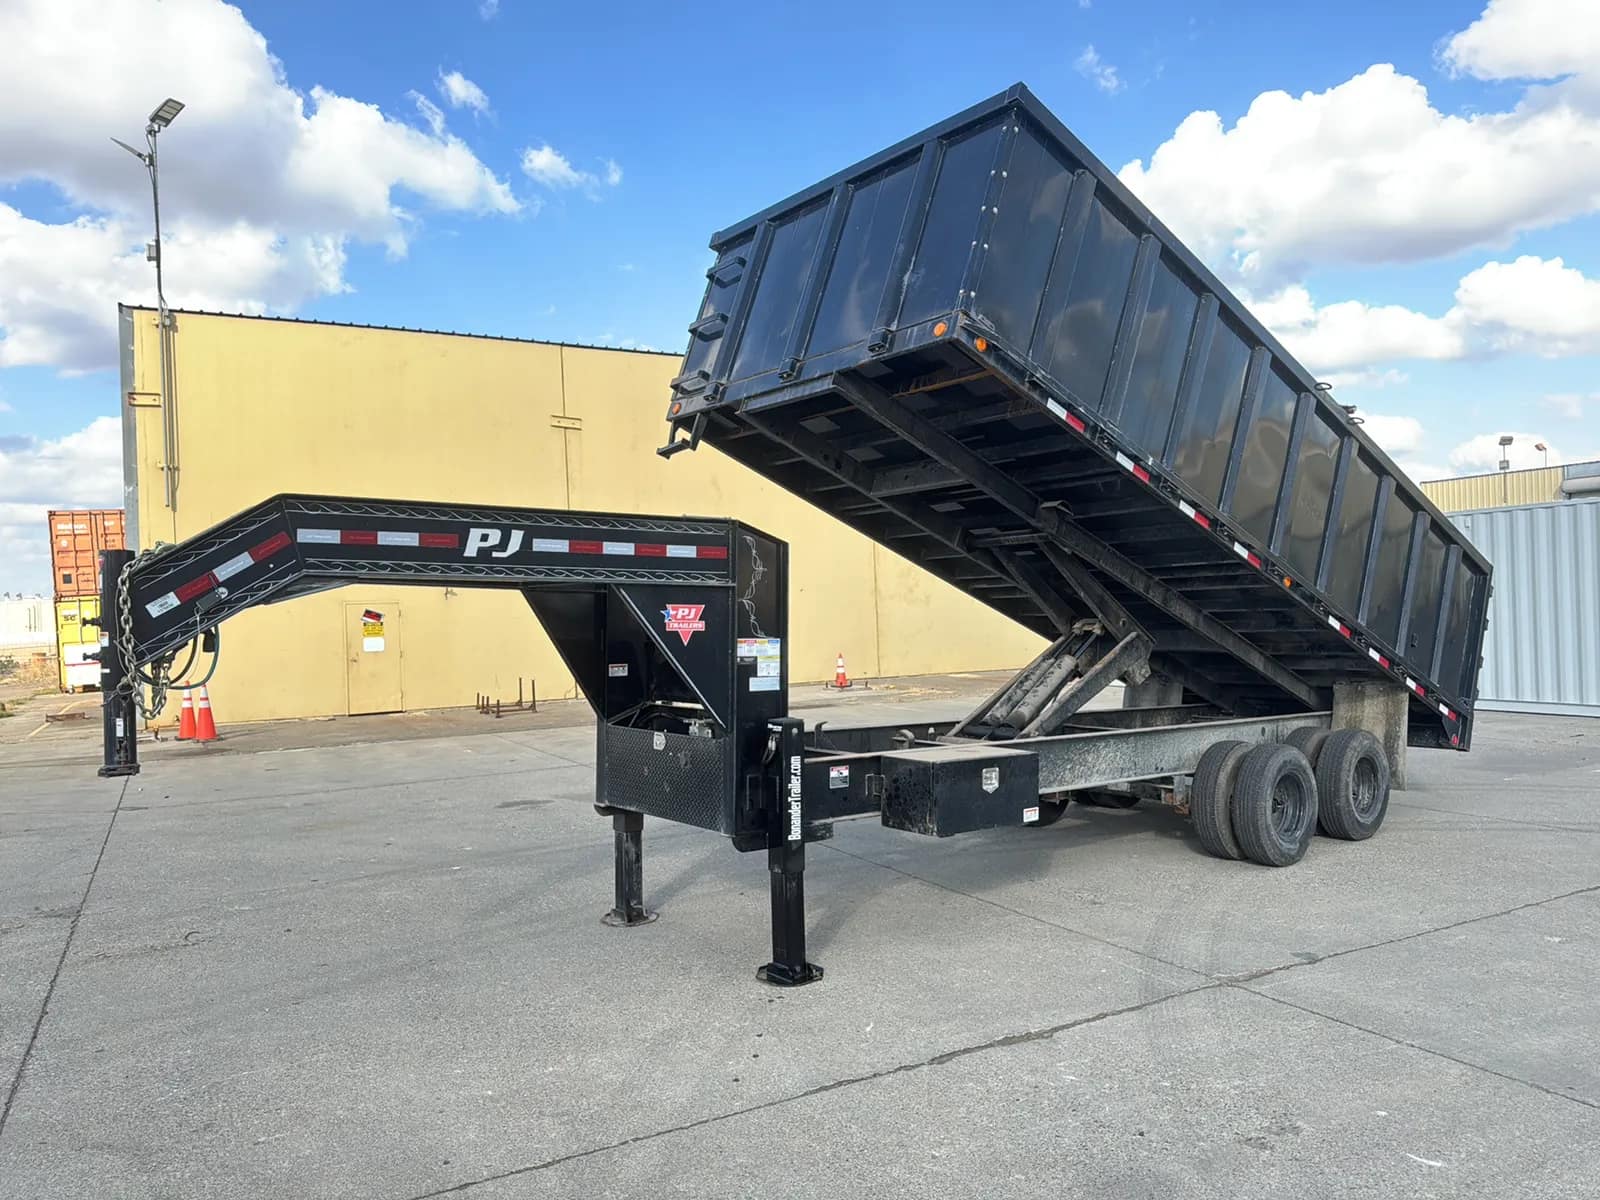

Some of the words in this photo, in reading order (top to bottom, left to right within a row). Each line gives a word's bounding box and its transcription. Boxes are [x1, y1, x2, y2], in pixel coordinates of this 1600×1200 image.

[463, 527, 525, 558] PJ
[676, 607, 697, 619] PJ
[788, 755, 802, 841] BonanderTrailer.com
